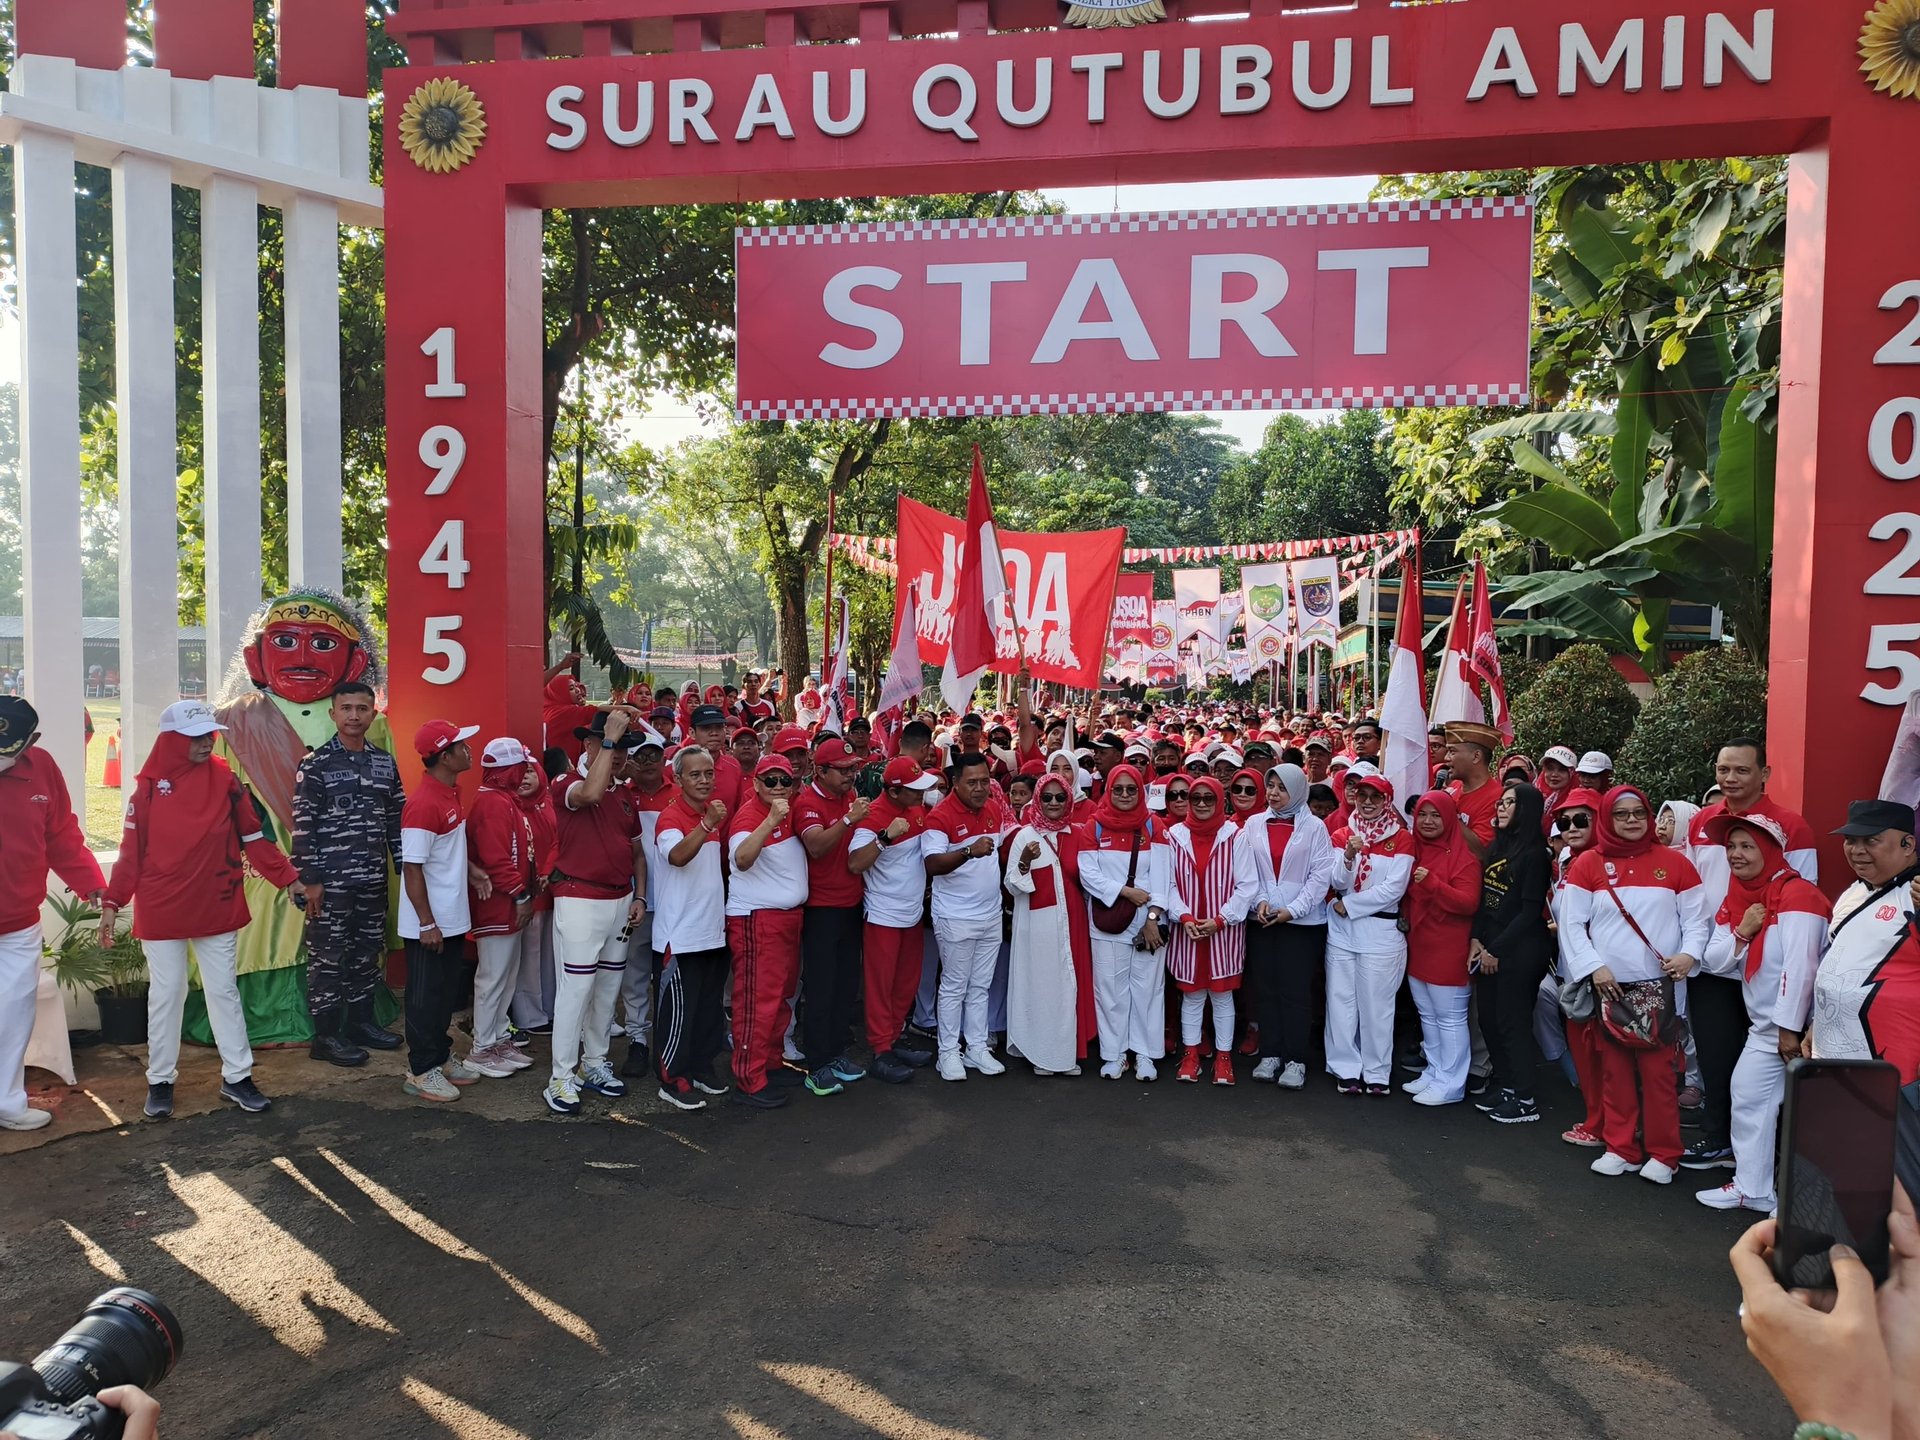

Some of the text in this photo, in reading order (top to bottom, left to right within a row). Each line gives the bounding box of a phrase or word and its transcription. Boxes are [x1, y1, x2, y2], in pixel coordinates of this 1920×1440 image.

[545, 8, 1775, 150] SURAU QUTUBUL AMIN
[818, 246, 1430, 369] START
[418, 327, 471, 685] 1945
[919, 531, 1072, 630] JQA
[330, 771, 350, 779] YONI
